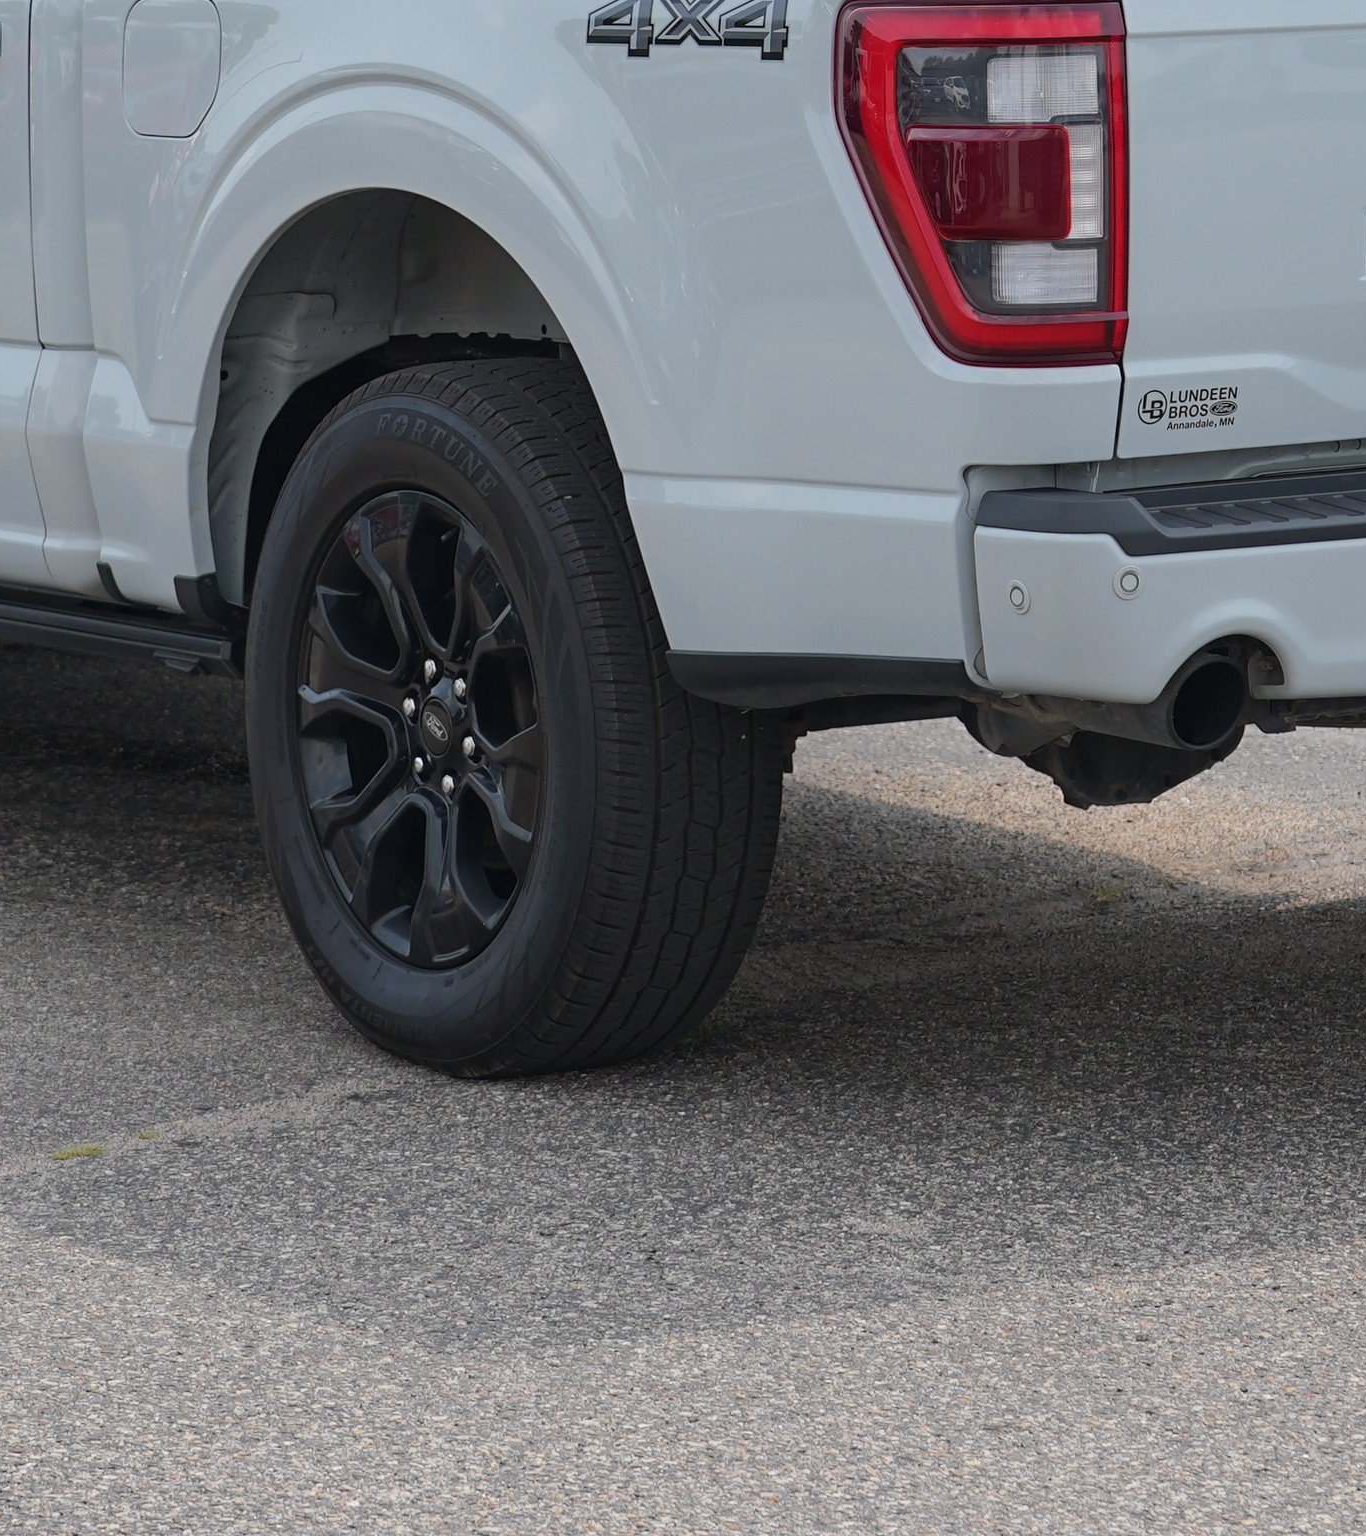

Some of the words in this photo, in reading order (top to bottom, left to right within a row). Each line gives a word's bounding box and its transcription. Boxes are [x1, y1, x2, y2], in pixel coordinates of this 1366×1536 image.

[1169, 386, 1238, 404] LUNDEEN
[1168, 403, 1209, 419] BROS
[1166, 418, 1218, 431] Annandale,
[1218, 417, 1235, 427] MN
[377, 413, 498, 498] FORTUNE
